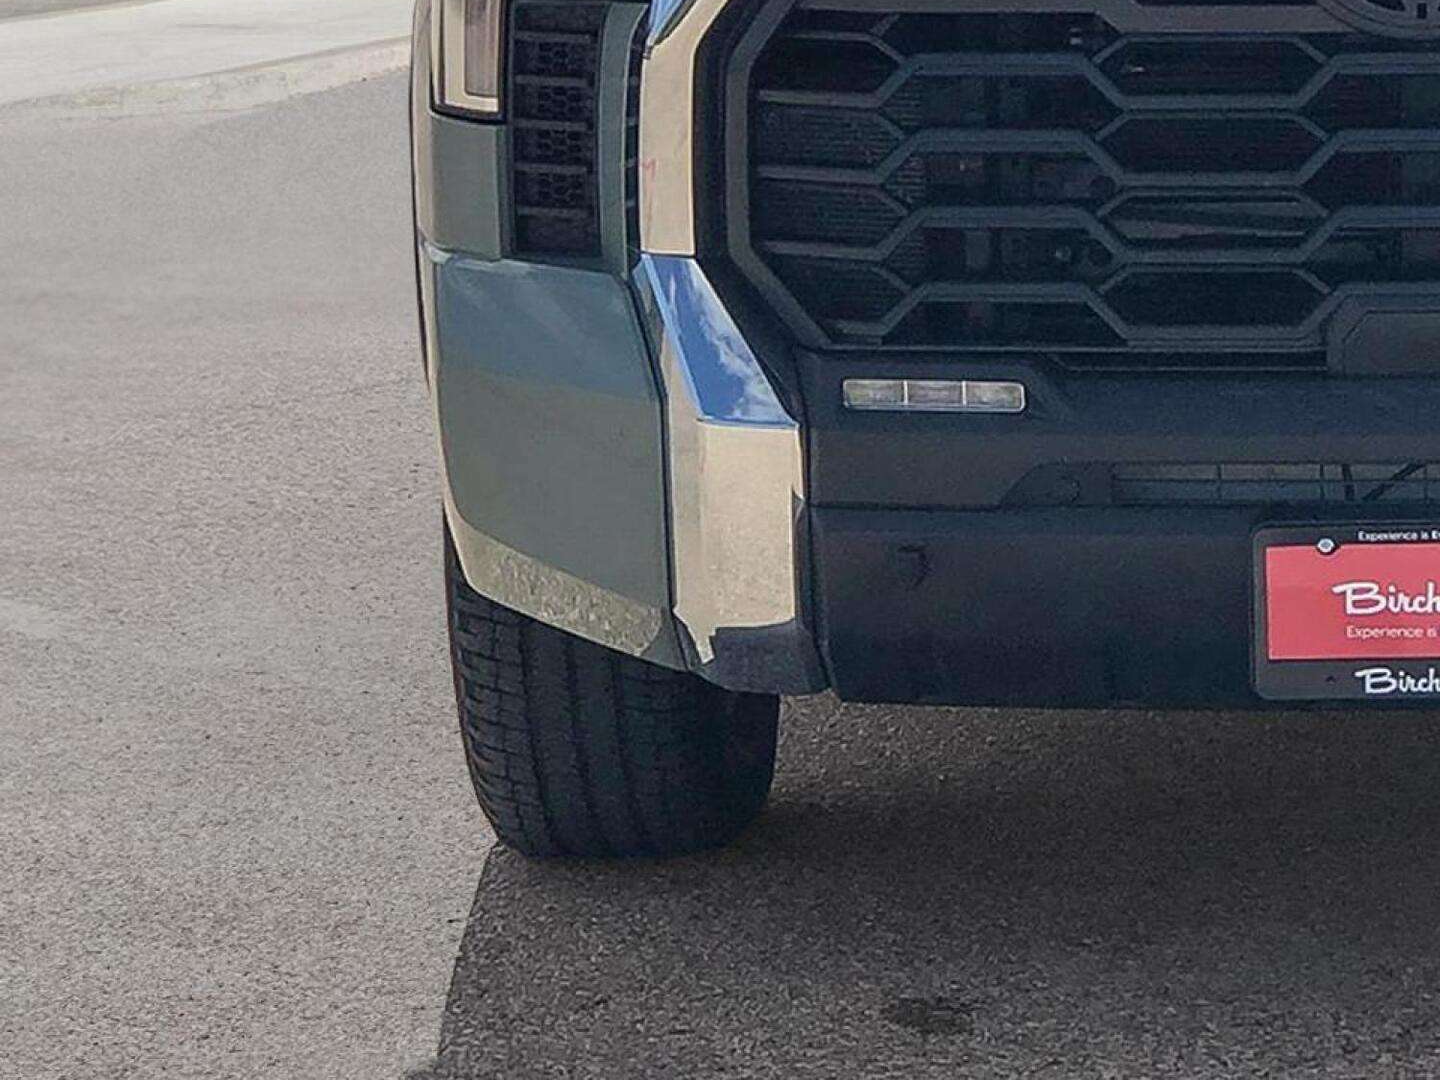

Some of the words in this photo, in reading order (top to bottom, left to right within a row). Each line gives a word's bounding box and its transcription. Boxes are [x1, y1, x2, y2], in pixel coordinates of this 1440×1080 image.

[1358, 530, 1418, 541] Experience
[1420, 530, 1429, 540] is
[1346, 625, 1424, 639] Experience
[1427, 626, 1438, 638] is
